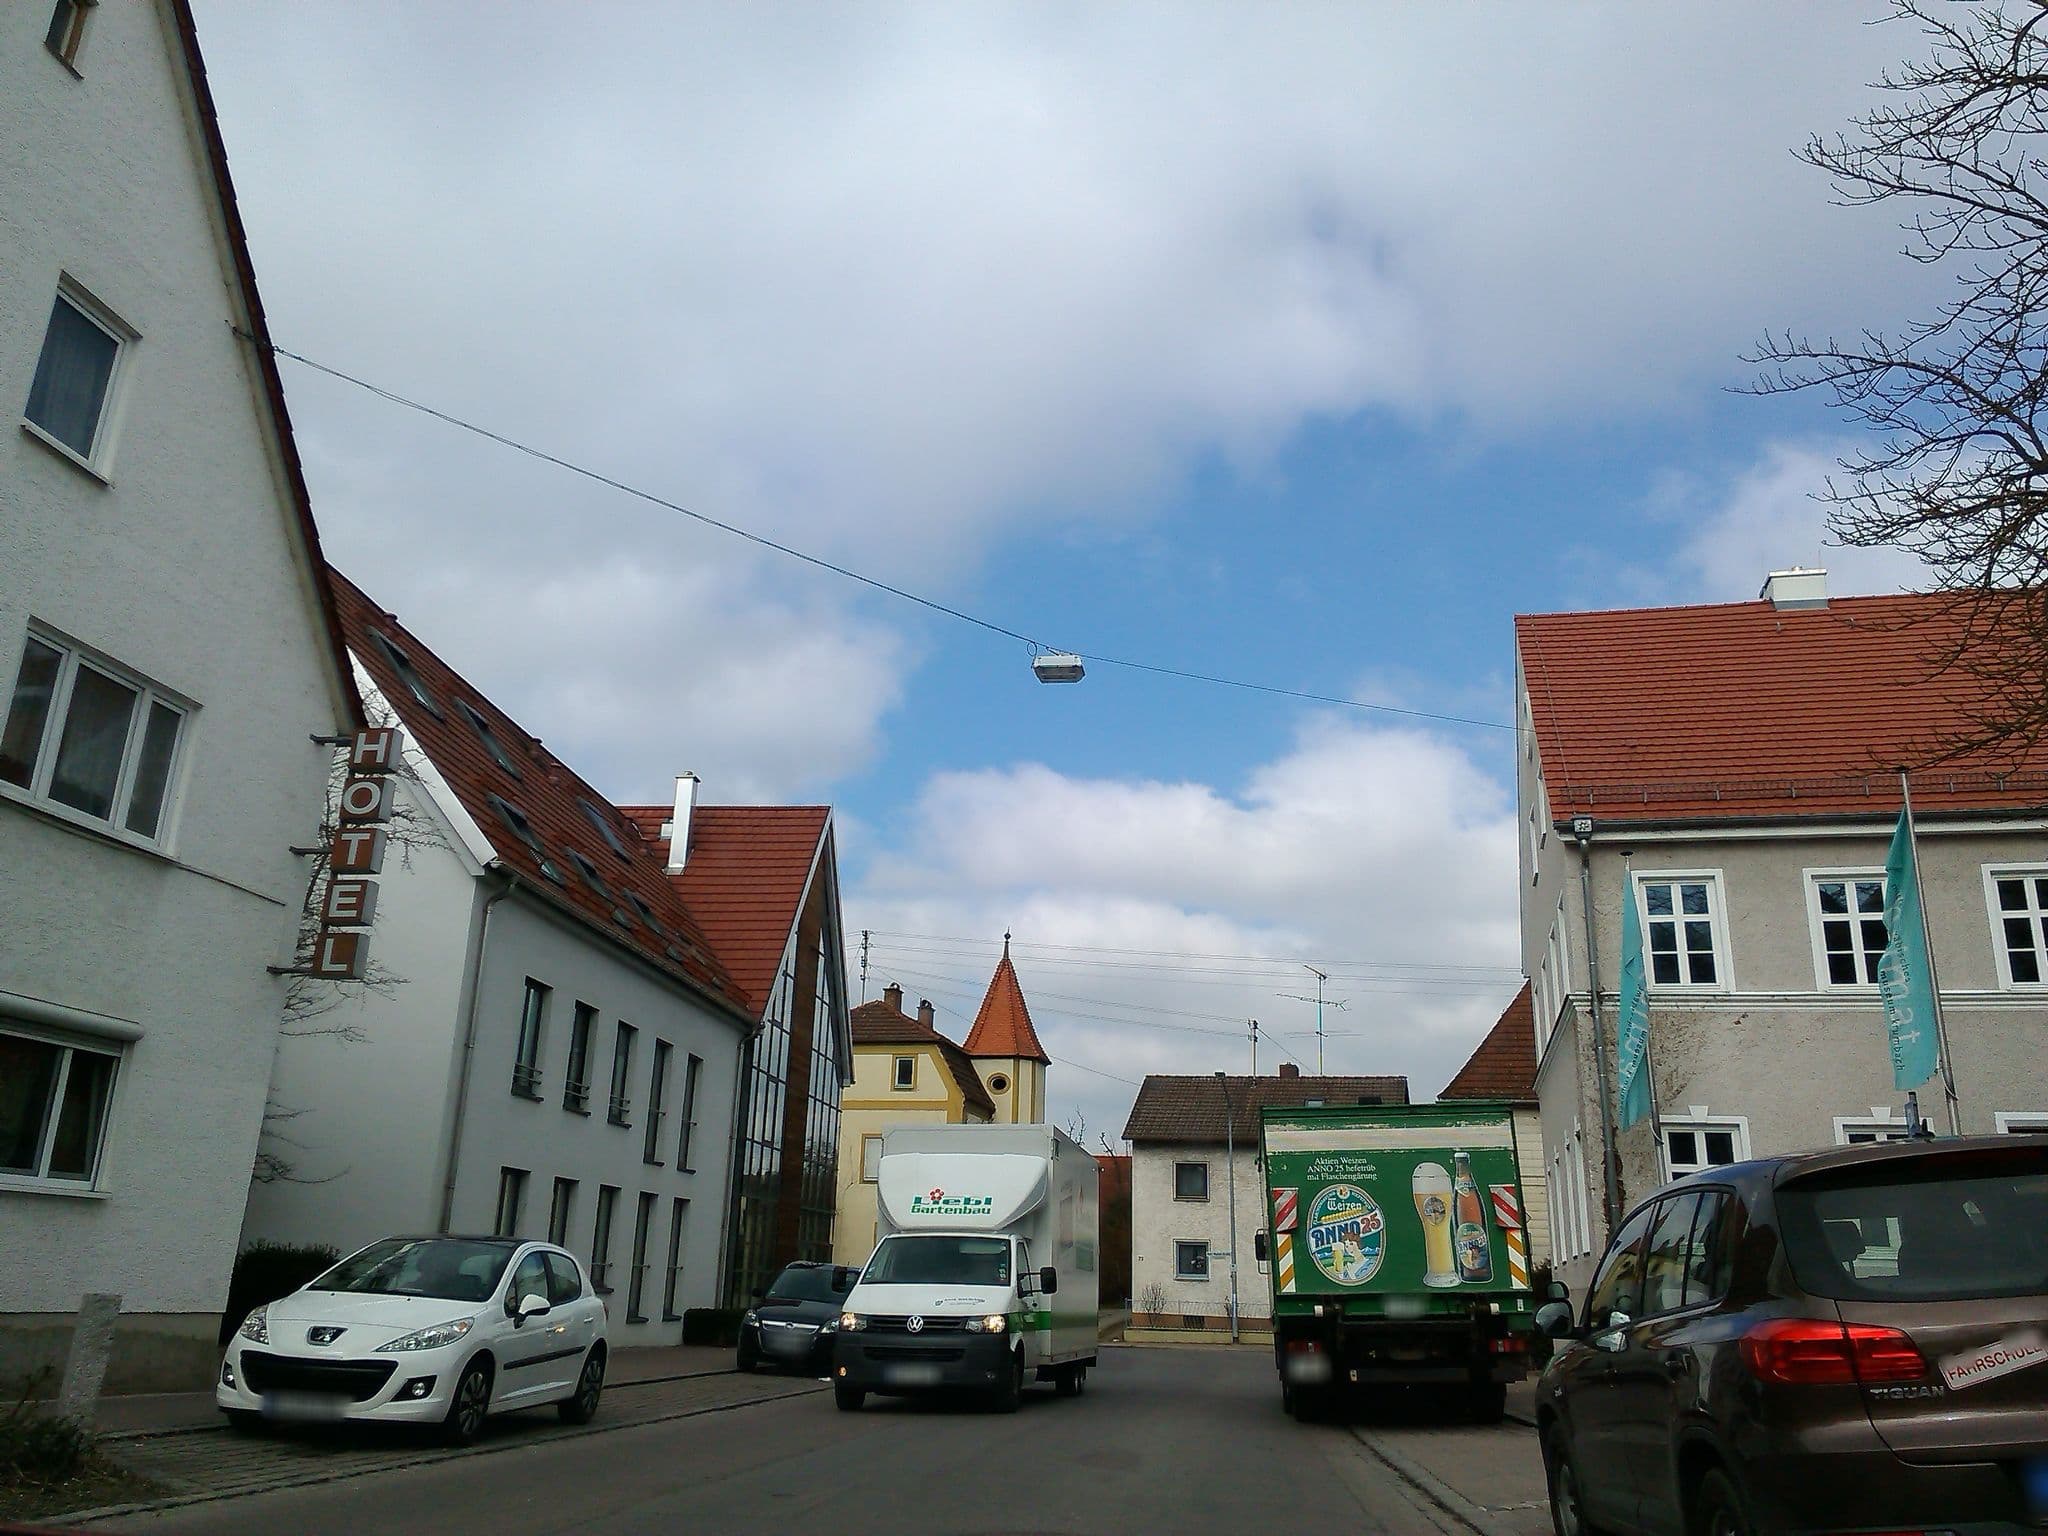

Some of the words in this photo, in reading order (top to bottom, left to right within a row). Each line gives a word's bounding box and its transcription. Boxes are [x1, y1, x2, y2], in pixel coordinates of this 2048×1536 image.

[321, 732, 388, 973] HOTEL
[1880, 970, 1897, 1015] museum
[1891, 1018, 1905, 1071] krumbach
[1315, 1157, 1338, 1165] Aktien
[1341, 1156, 1367, 1164] Weizen
[1307, 1165, 1333, 1173] ANNO
[1335, 1165, 1344, 1173] 25
[911, 1204, 991, 1215] Gartenbau
[1311, 1220, 1361, 1248] ANNO
[1360, 1213, 1382, 1234] 25
[1869, 1385, 1945, 1399] TIGUAN
